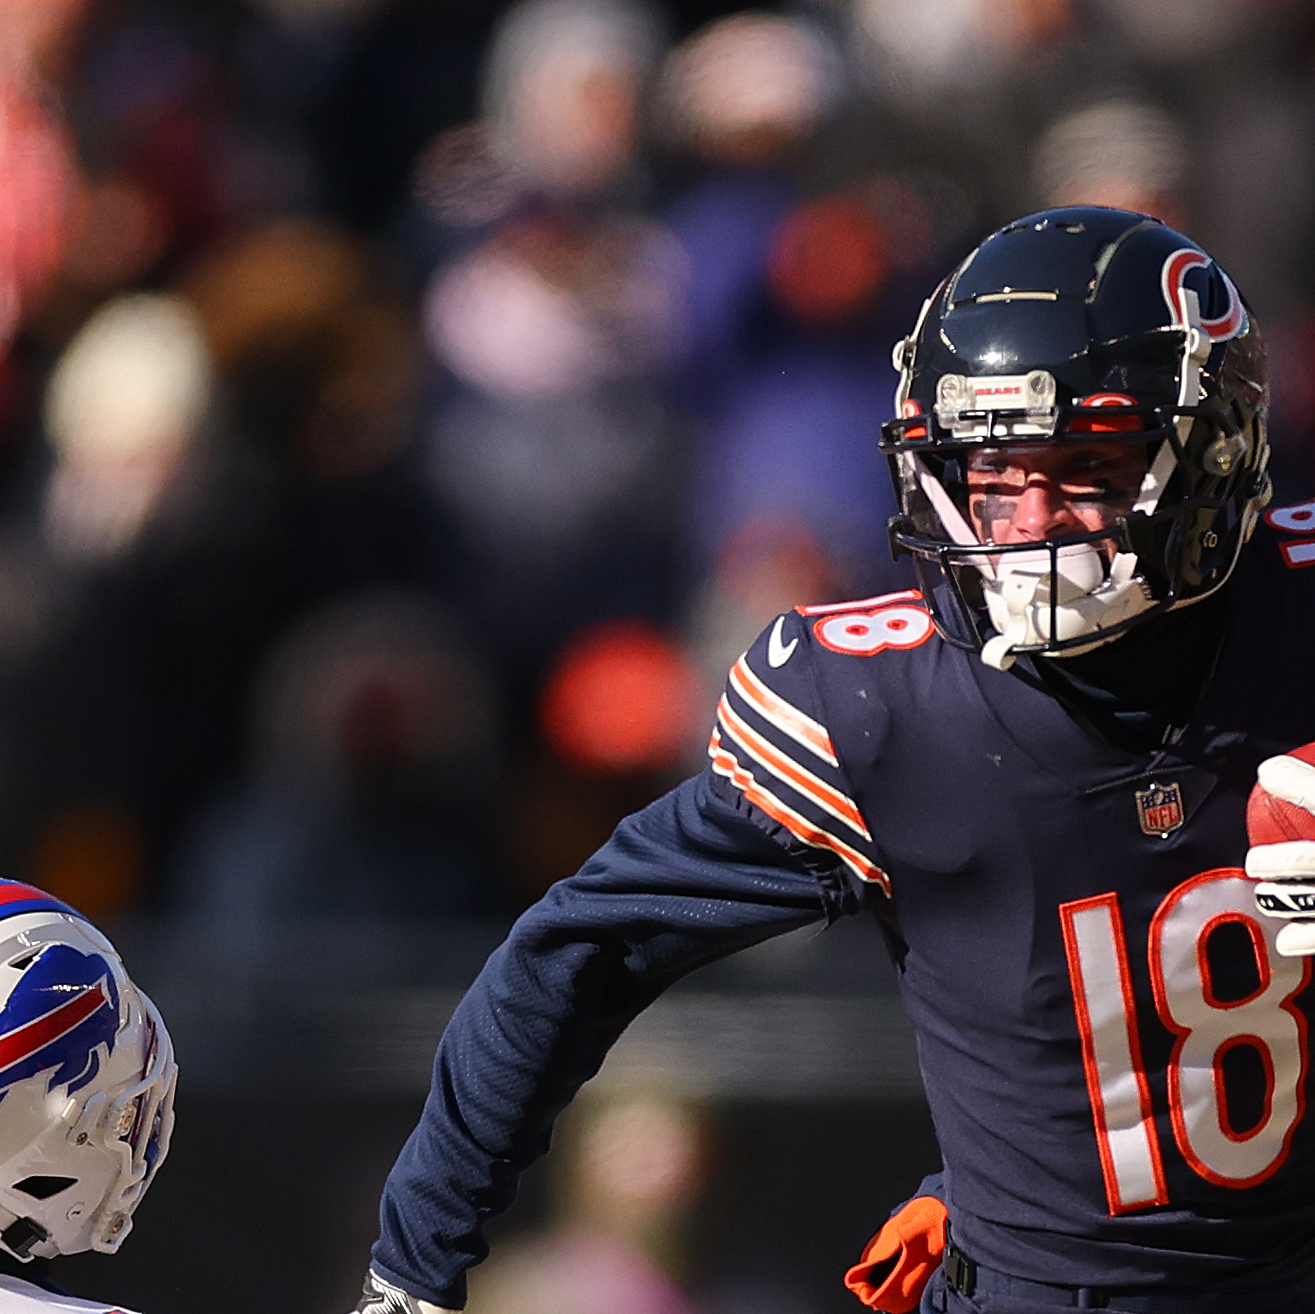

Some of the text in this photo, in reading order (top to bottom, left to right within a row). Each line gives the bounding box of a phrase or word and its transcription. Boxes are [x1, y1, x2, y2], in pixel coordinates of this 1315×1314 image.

[974, 386, 1022, 396] BEARS
[794, 589, 936, 657] 18
[1146, 804, 1180, 828] NFL
[1058, 867, 1312, 1217] 18
